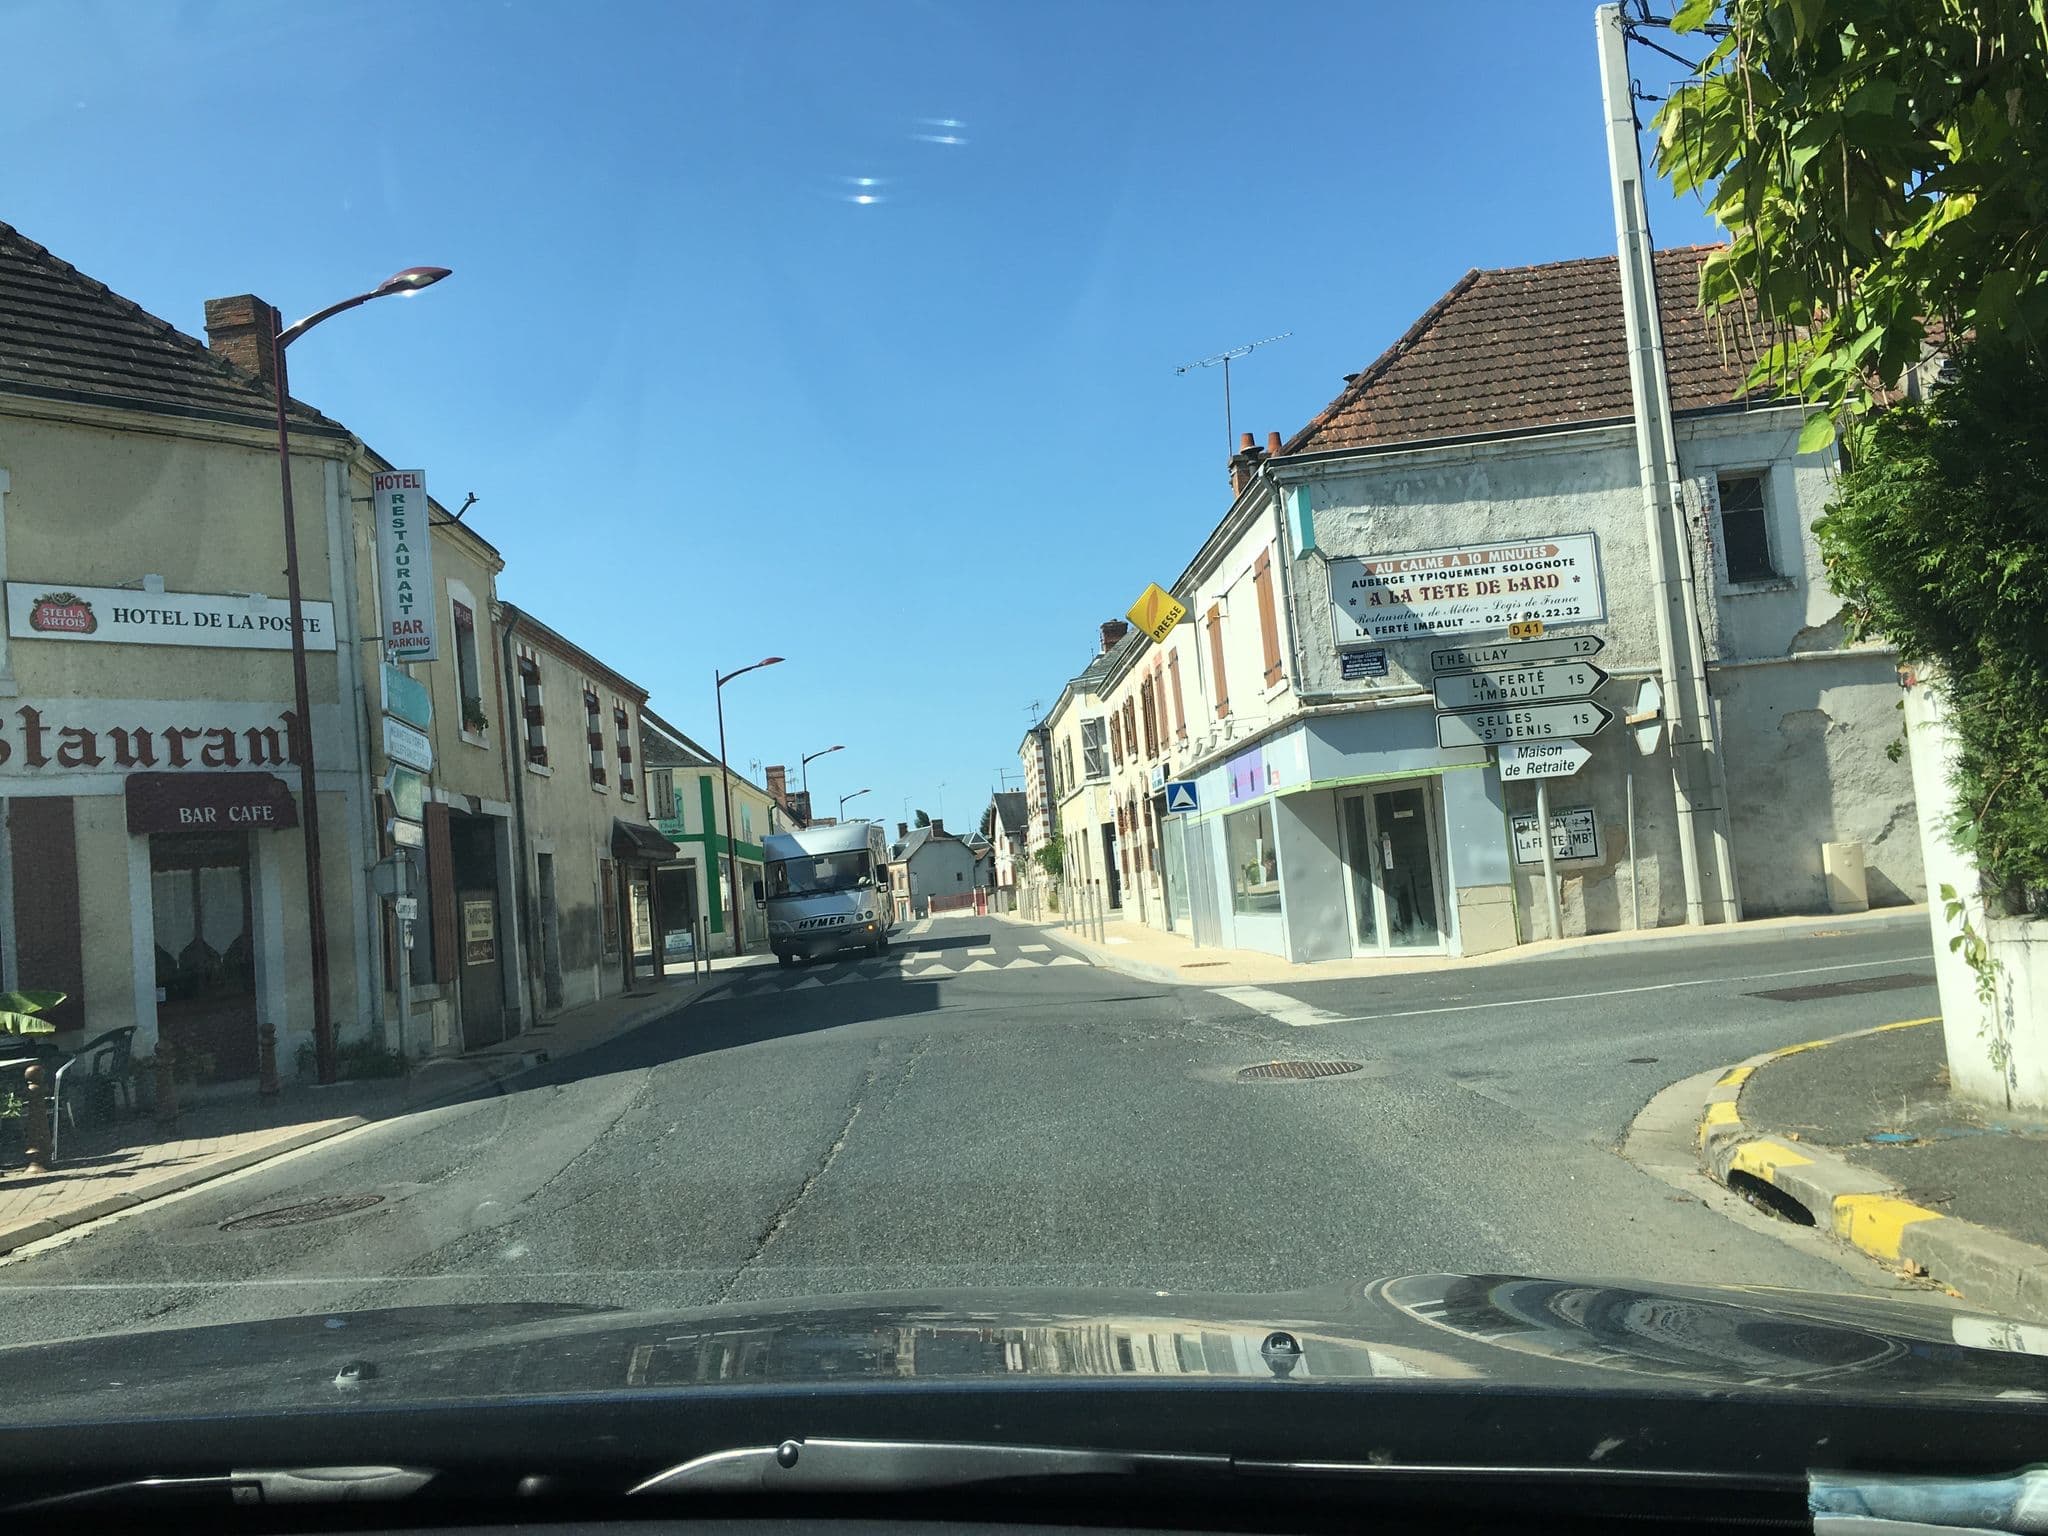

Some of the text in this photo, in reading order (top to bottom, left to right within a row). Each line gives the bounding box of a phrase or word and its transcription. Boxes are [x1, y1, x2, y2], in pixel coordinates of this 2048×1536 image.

[375, 473, 420, 491] HOTEL
[391, 493, 413, 615] RESTAURANT
[1375, 546, 1547, 575] AU CALME A 10 MINUTES
[1351, 558, 1576, 589] AUBERGE TYPIQUEMENT SOLOGNOTE
[1369, 573, 1560, 607] A LA TETE DE LARD
[42, 608, 85, 618] STELLA
[1427, 607, 1441, 617] de
[1525, 597, 1536, 607] de
[1540, 595, 1579, 606] France
[42, 617, 86, 627] ARTOIS
[112, 607, 321, 633] HOTEL DE LA POSTE
[392, 619, 424, 635] BAR
[1153, 605, 1182, 639] PRESSE
[1355, 628, 1370, 637] LA
[1375, 622, 1409, 635] FERTÉ
[1414, 618, 1464, 632] IMBAULT
[1512, 623, 1539, 636] D 41
[388, 636, 430, 649] PARKING
[1437, 640, 1590, 665] THEILLAY 12
[1472, 670, 1585, 688] LA FERTÉ 15
[1476, 712, 1589, 727] SELLES 15
[1505, 723, 1552, 738] DENIS
[1517, 745, 1562, 759] Maison
[1505, 759, 1575, 776] de Retraite
[179, 805, 274, 823] BAR CAFE
[1559, 846, 1574, 857] 41
[798, 916, 846, 929] HYMER
